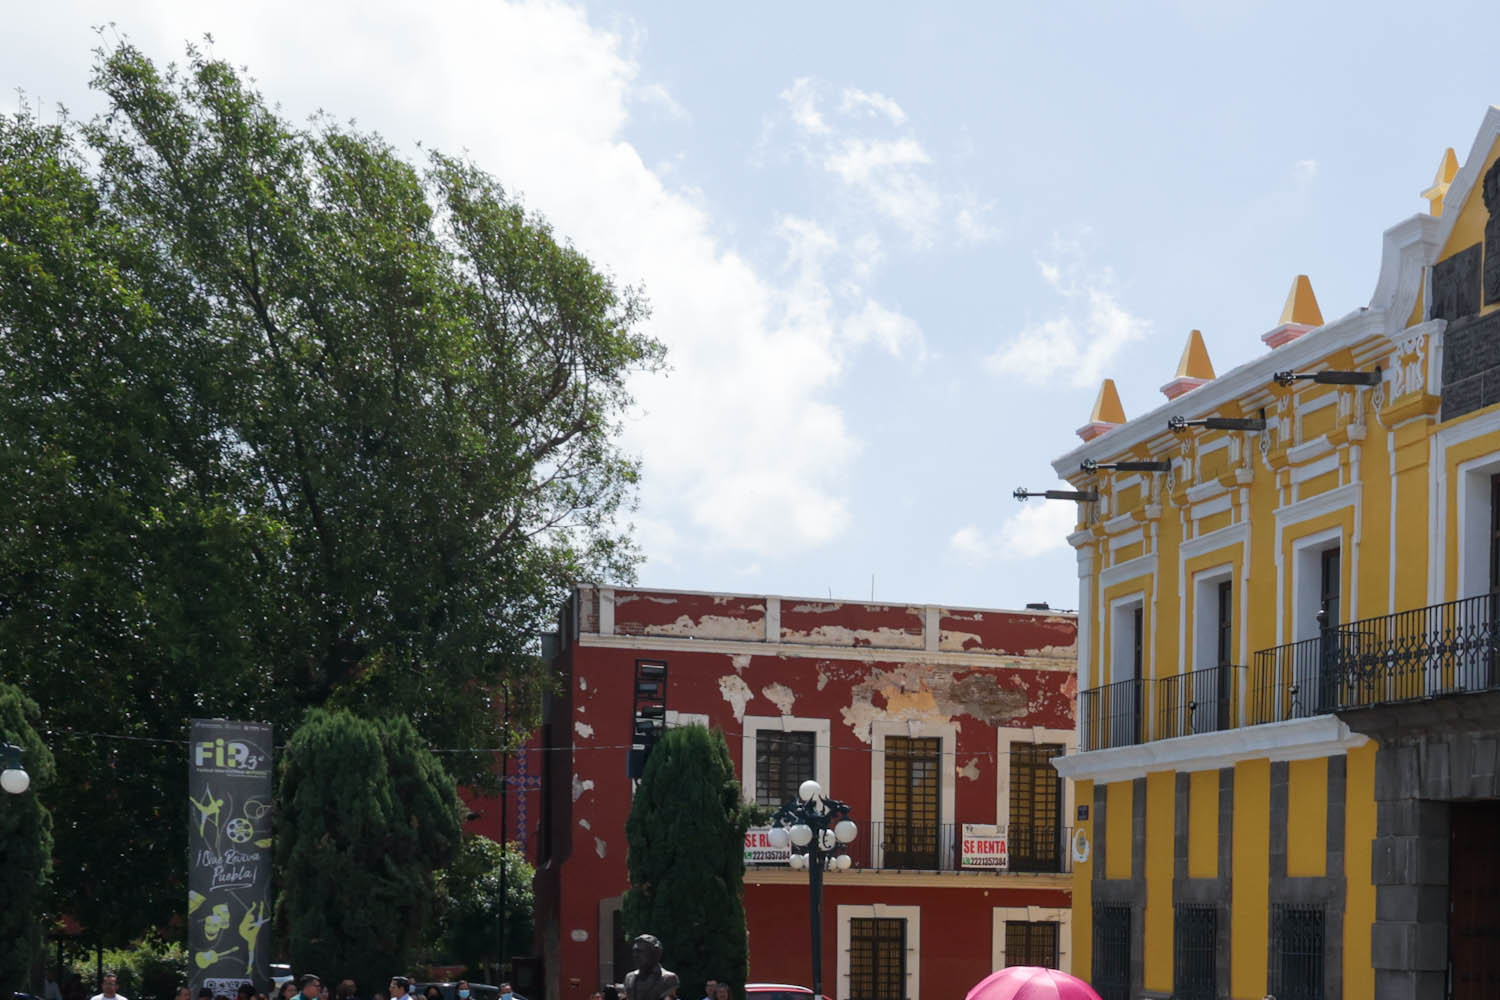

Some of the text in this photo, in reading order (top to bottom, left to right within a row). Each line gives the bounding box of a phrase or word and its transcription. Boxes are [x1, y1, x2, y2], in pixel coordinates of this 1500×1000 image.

[745, 833, 757, 848] SE
[963, 840, 1006, 854] SE RENTA
